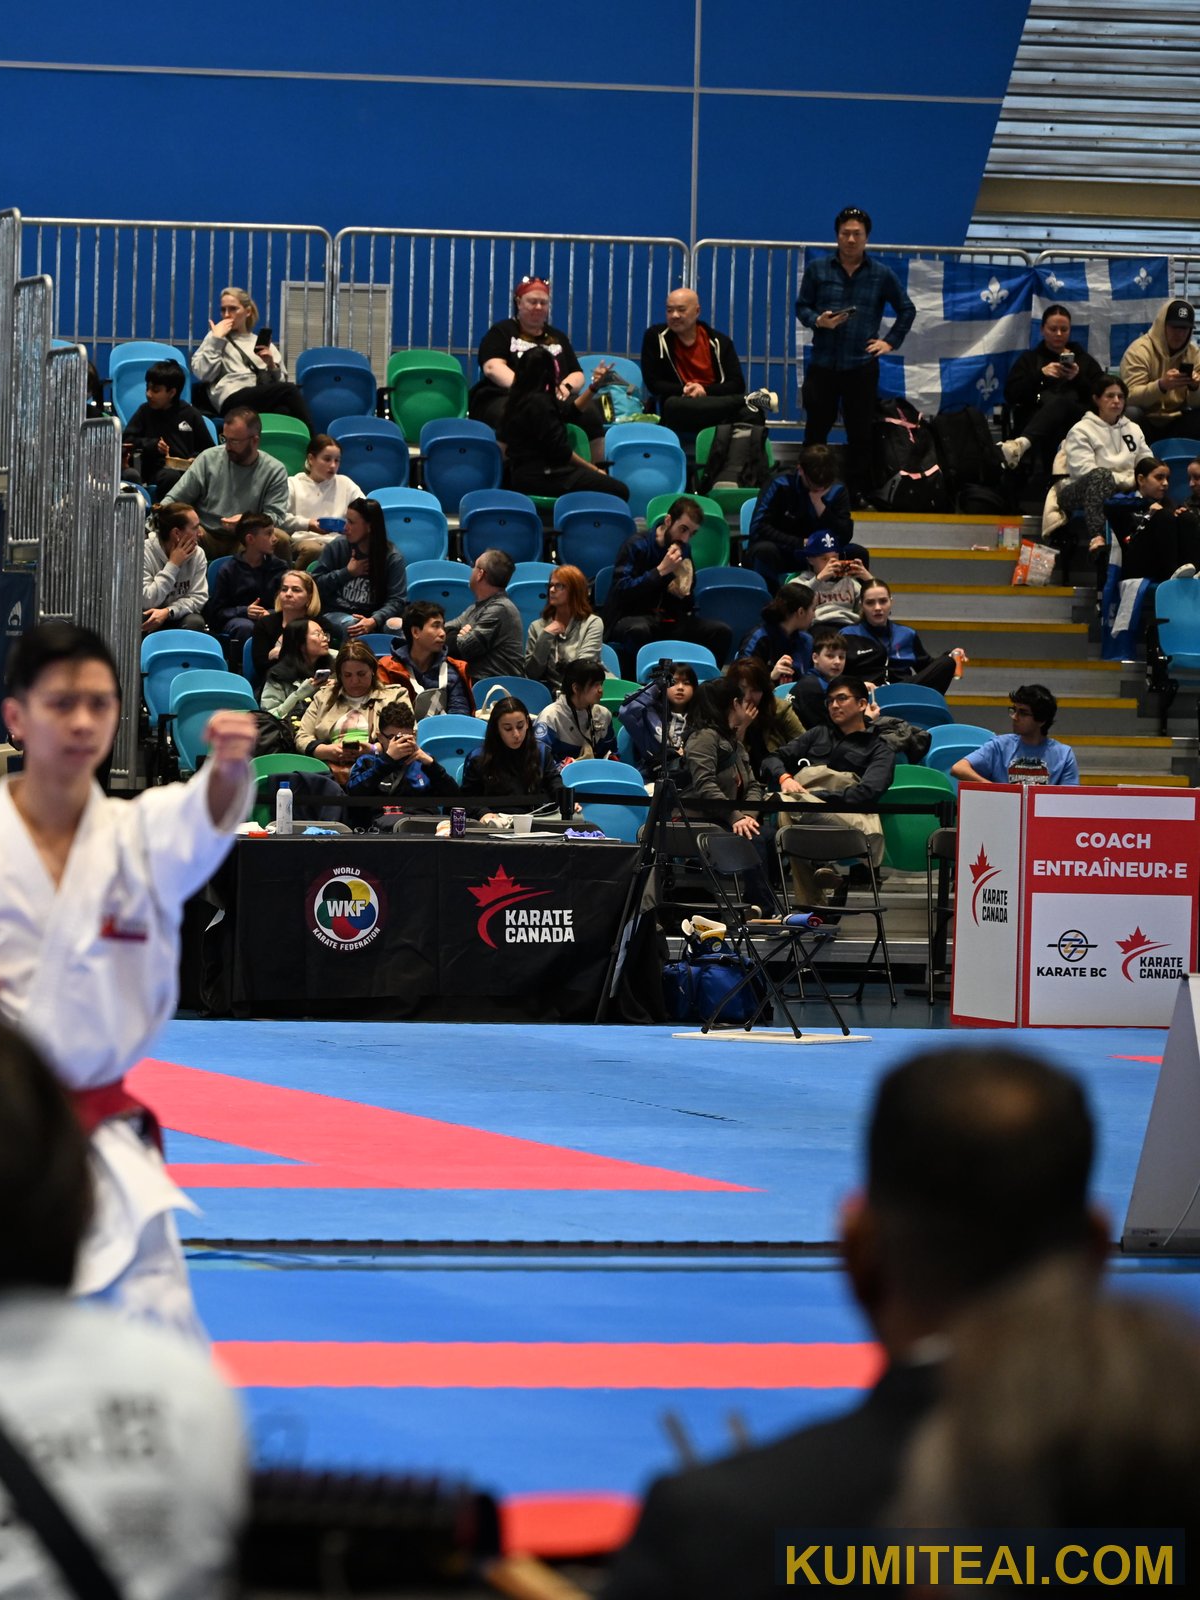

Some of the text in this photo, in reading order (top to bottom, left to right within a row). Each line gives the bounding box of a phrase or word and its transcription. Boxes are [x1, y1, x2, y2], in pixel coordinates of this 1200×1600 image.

[1122, 434, 1137, 452] B
[1075, 832, 1151, 849] COACH
[333, 867, 361, 876] WORLD
[982, 888, 1008, 906] KARATE
[326, 900, 366, 917] WKF
[982, 906, 1008, 923] CANADA
[505, 909, 573, 926] KARATE
[312, 926, 381, 951] KARATE FEDERATION
[505, 927, 575, 943] CANADA
[1139, 956, 1183, 968] KARATE
[1037, 966, 1107, 978] KARATE BC
[1139, 968, 1183, 980] CANADA
